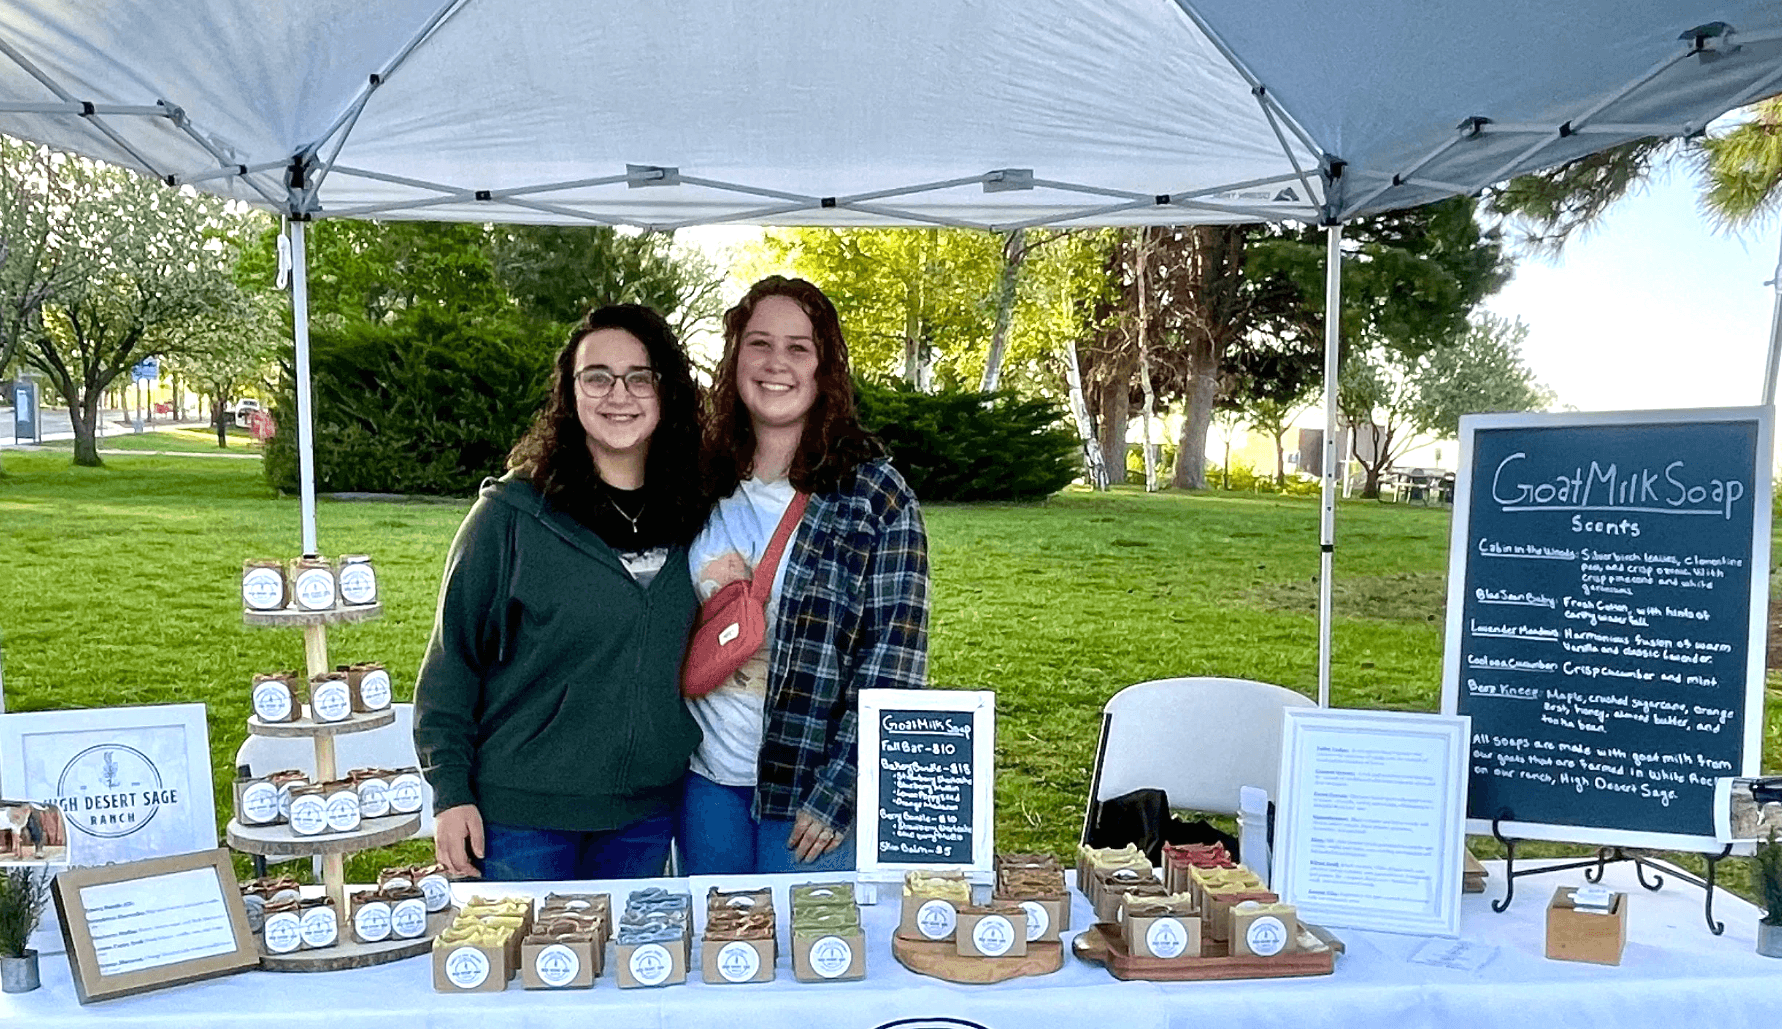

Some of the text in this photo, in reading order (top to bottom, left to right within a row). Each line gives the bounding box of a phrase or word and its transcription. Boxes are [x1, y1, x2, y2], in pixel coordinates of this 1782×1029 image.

[1492, 452, 1744, 519] Goat Milk Soap
[1571, 514, 1641, 537] Scents
[1479, 538, 1512, 553] Cabin
[1514, 544, 1525, 554] in
[1658, 577, 1679, 587] and
[1563, 596, 1595, 609] Fresh
[1636, 606, 1663, 617] with
[1695, 609, 1711, 621] of
[1600, 646, 1619, 655] and
[1676, 639, 1692, 649] of
[1694, 641, 1732, 652] warm
[1467, 654, 1488, 666] Cool
[1563, 661, 1600, 678] Crisp
[1661, 673, 1681, 684] and
[1694, 705, 1735, 724] orange
[882, 715, 972, 740] Goat Milk Soap
[1696, 723, 1721, 734] and
[1472, 733, 1490, 744] All
[1534, 741, 1555, 750] are
[1559, 743, 1592, 756] made
[1596, 748, 1627, 759] with
[1632, 751, 1660, 766] goat
[1662, 752, 1693, 765] milk
[1697, 754, 1733, 771] from
[1473, 750, 1493, 759] our
[1497, 753, 1526, 767] goats
[1528, 755, 1553, 766] that
[1556, 759, 1576, 769] are
[1579, 758, 1625, 775] farmed
[1630, 767, 1644, 778] in
[1689, 773, 1718, 787] Roc
[1474, 766, 1489, 775] on
[1494, 768, 1516, 779] our
[1520, 770, 1556, 786] ranch,
[1560, 772, 1590, 793] High
[43, 789, 178, 812] GH DESERT SAGE
[90, 812, 135, 826] RANCH
